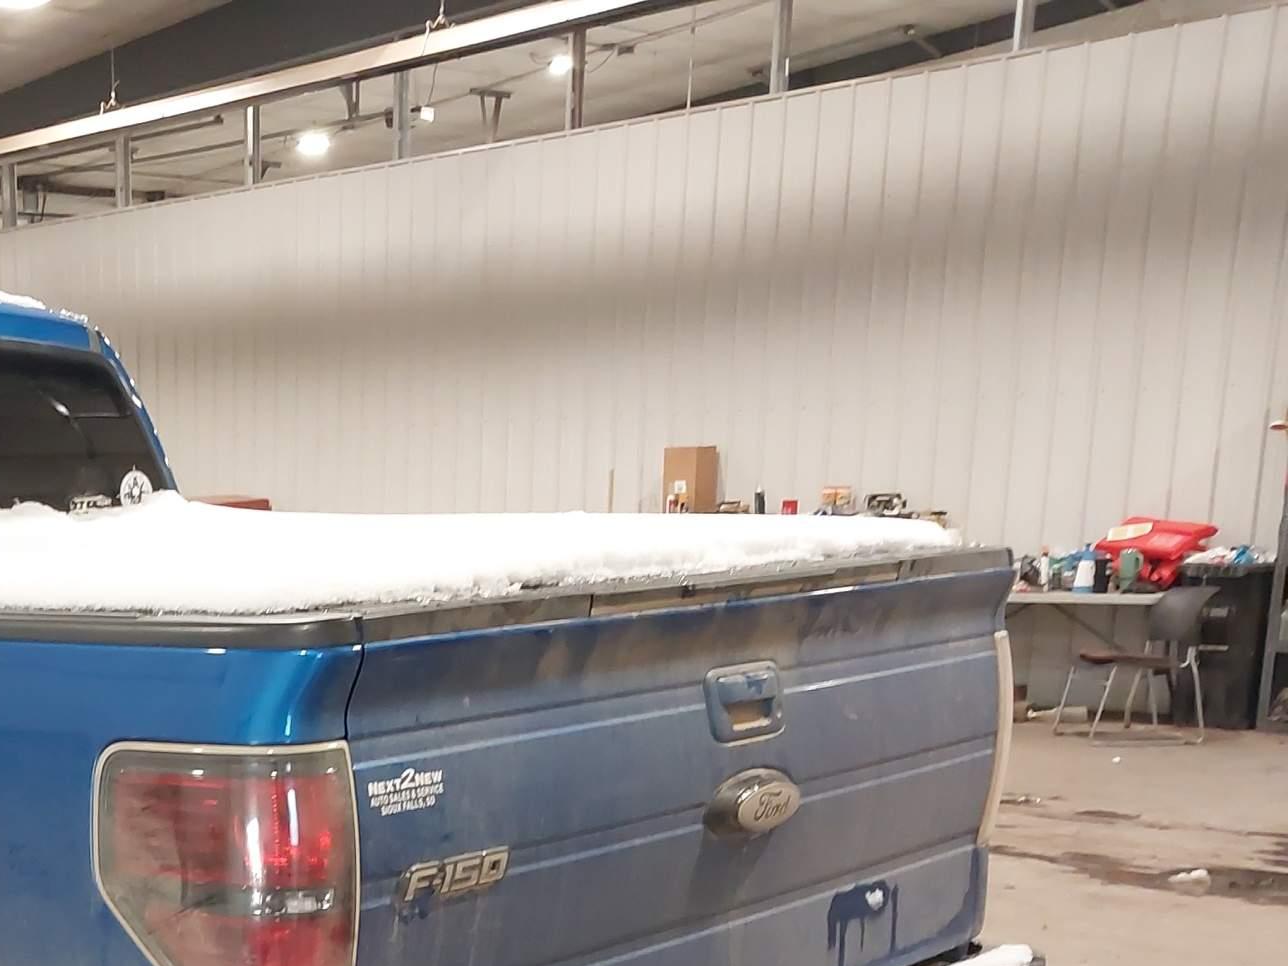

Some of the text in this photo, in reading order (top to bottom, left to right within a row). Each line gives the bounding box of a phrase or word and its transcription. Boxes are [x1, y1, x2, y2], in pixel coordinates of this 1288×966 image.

[370, 795, 389, 808] AUTO
[389, 789, 411, 803] SALES
[417, 782, 444, 798] SERVICE
[754, 790, 791, 822] Ford
